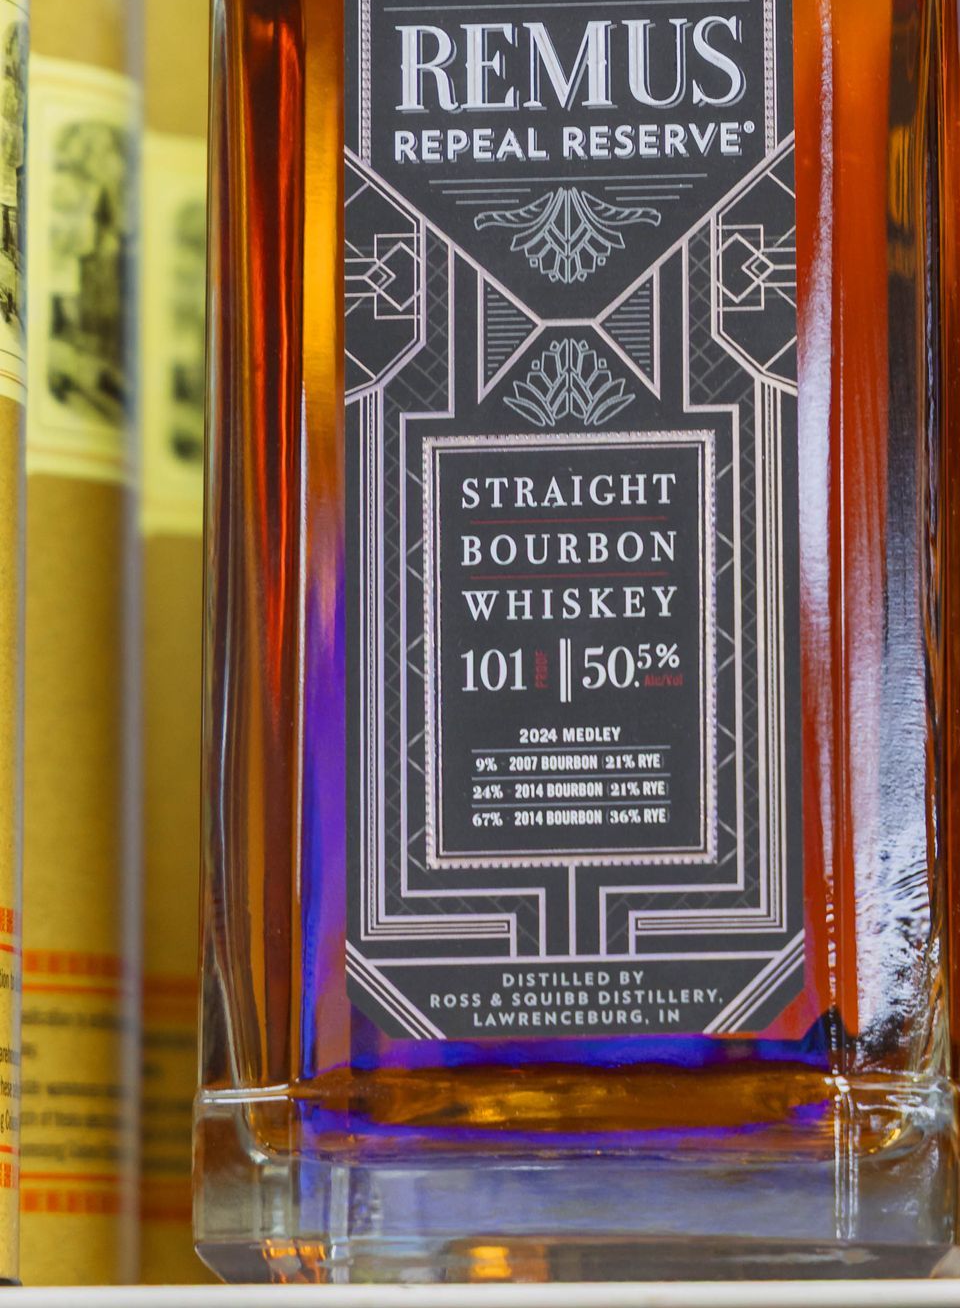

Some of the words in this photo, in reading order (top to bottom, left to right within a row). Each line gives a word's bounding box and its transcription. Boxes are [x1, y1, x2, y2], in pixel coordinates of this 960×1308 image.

[395, 15, 747, 113] REMUS
[394, 127, 548, 163] REPEAL
[461, 473, 676, 509] STRAIGHT
[461, 530, 677, 566] BOURBON
[461, 585, 677, 622] WHISKEY
[460, 647, 528, 691] 101
[519, 728, 558, 744] 2024
[562, 726, 621, 743] MEDLEY
[475, 757, 498, 772] 9%
[509, 755, 538, 772] 2007
[541, 754, 598, 771] BOURBON
[472, 784, 504, 799] 24%
[514, 782, 544, 799] 2014
[546, 782, 603, 798] BOURBON
[472, 811, 504, 827] 67%
[514, 810, 544, 827] 2014
[546, 809, 603, 826] BOURBON
[502, 970, 612, 988] DISTILLED
[620, 970, 645, 986] BY
[430, 992, 482, 1009] ROSS
[489, 993, 503, 1007] &
[511, 991, 590, 1007] SQUIBB
[598, 988, 724, 1006] DISTILLERY,
[473, 1009, 651, 1028] LAWRENCEBURG,
[658, 1008, 681, 1024] IN
